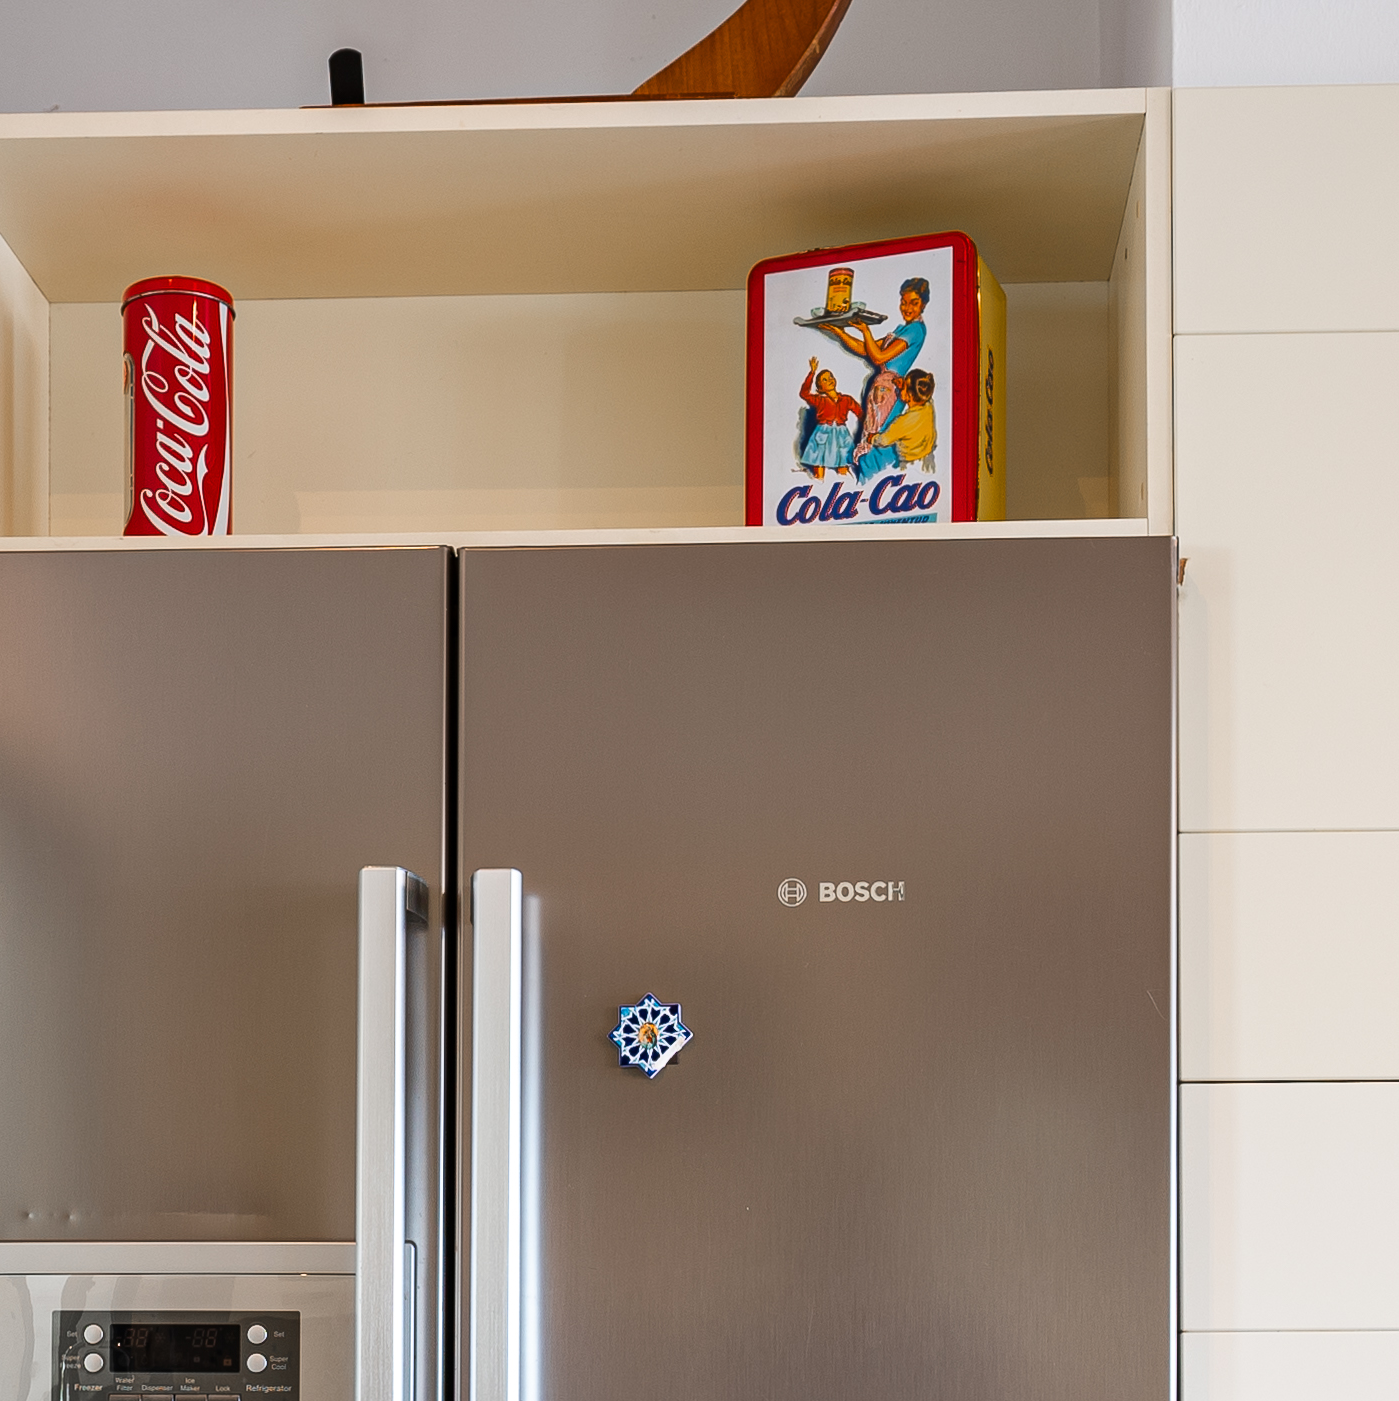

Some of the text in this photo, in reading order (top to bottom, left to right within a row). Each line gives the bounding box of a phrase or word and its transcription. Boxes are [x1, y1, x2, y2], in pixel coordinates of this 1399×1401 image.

[139, 302, 211, 536] Coca-Cola
[776, 473, 941, 527] Cola-Cao
[819, 880, 906, 902] BOSCH
[269, 1355, 289, 1363] Super
[74, 1383, 103, 1391] Freezer
[142, 1384, 174, 1393] Dispenser
[180, 1384, 201, 1392] Maker
[245, 1384, 292, 1394] Refrigerator
